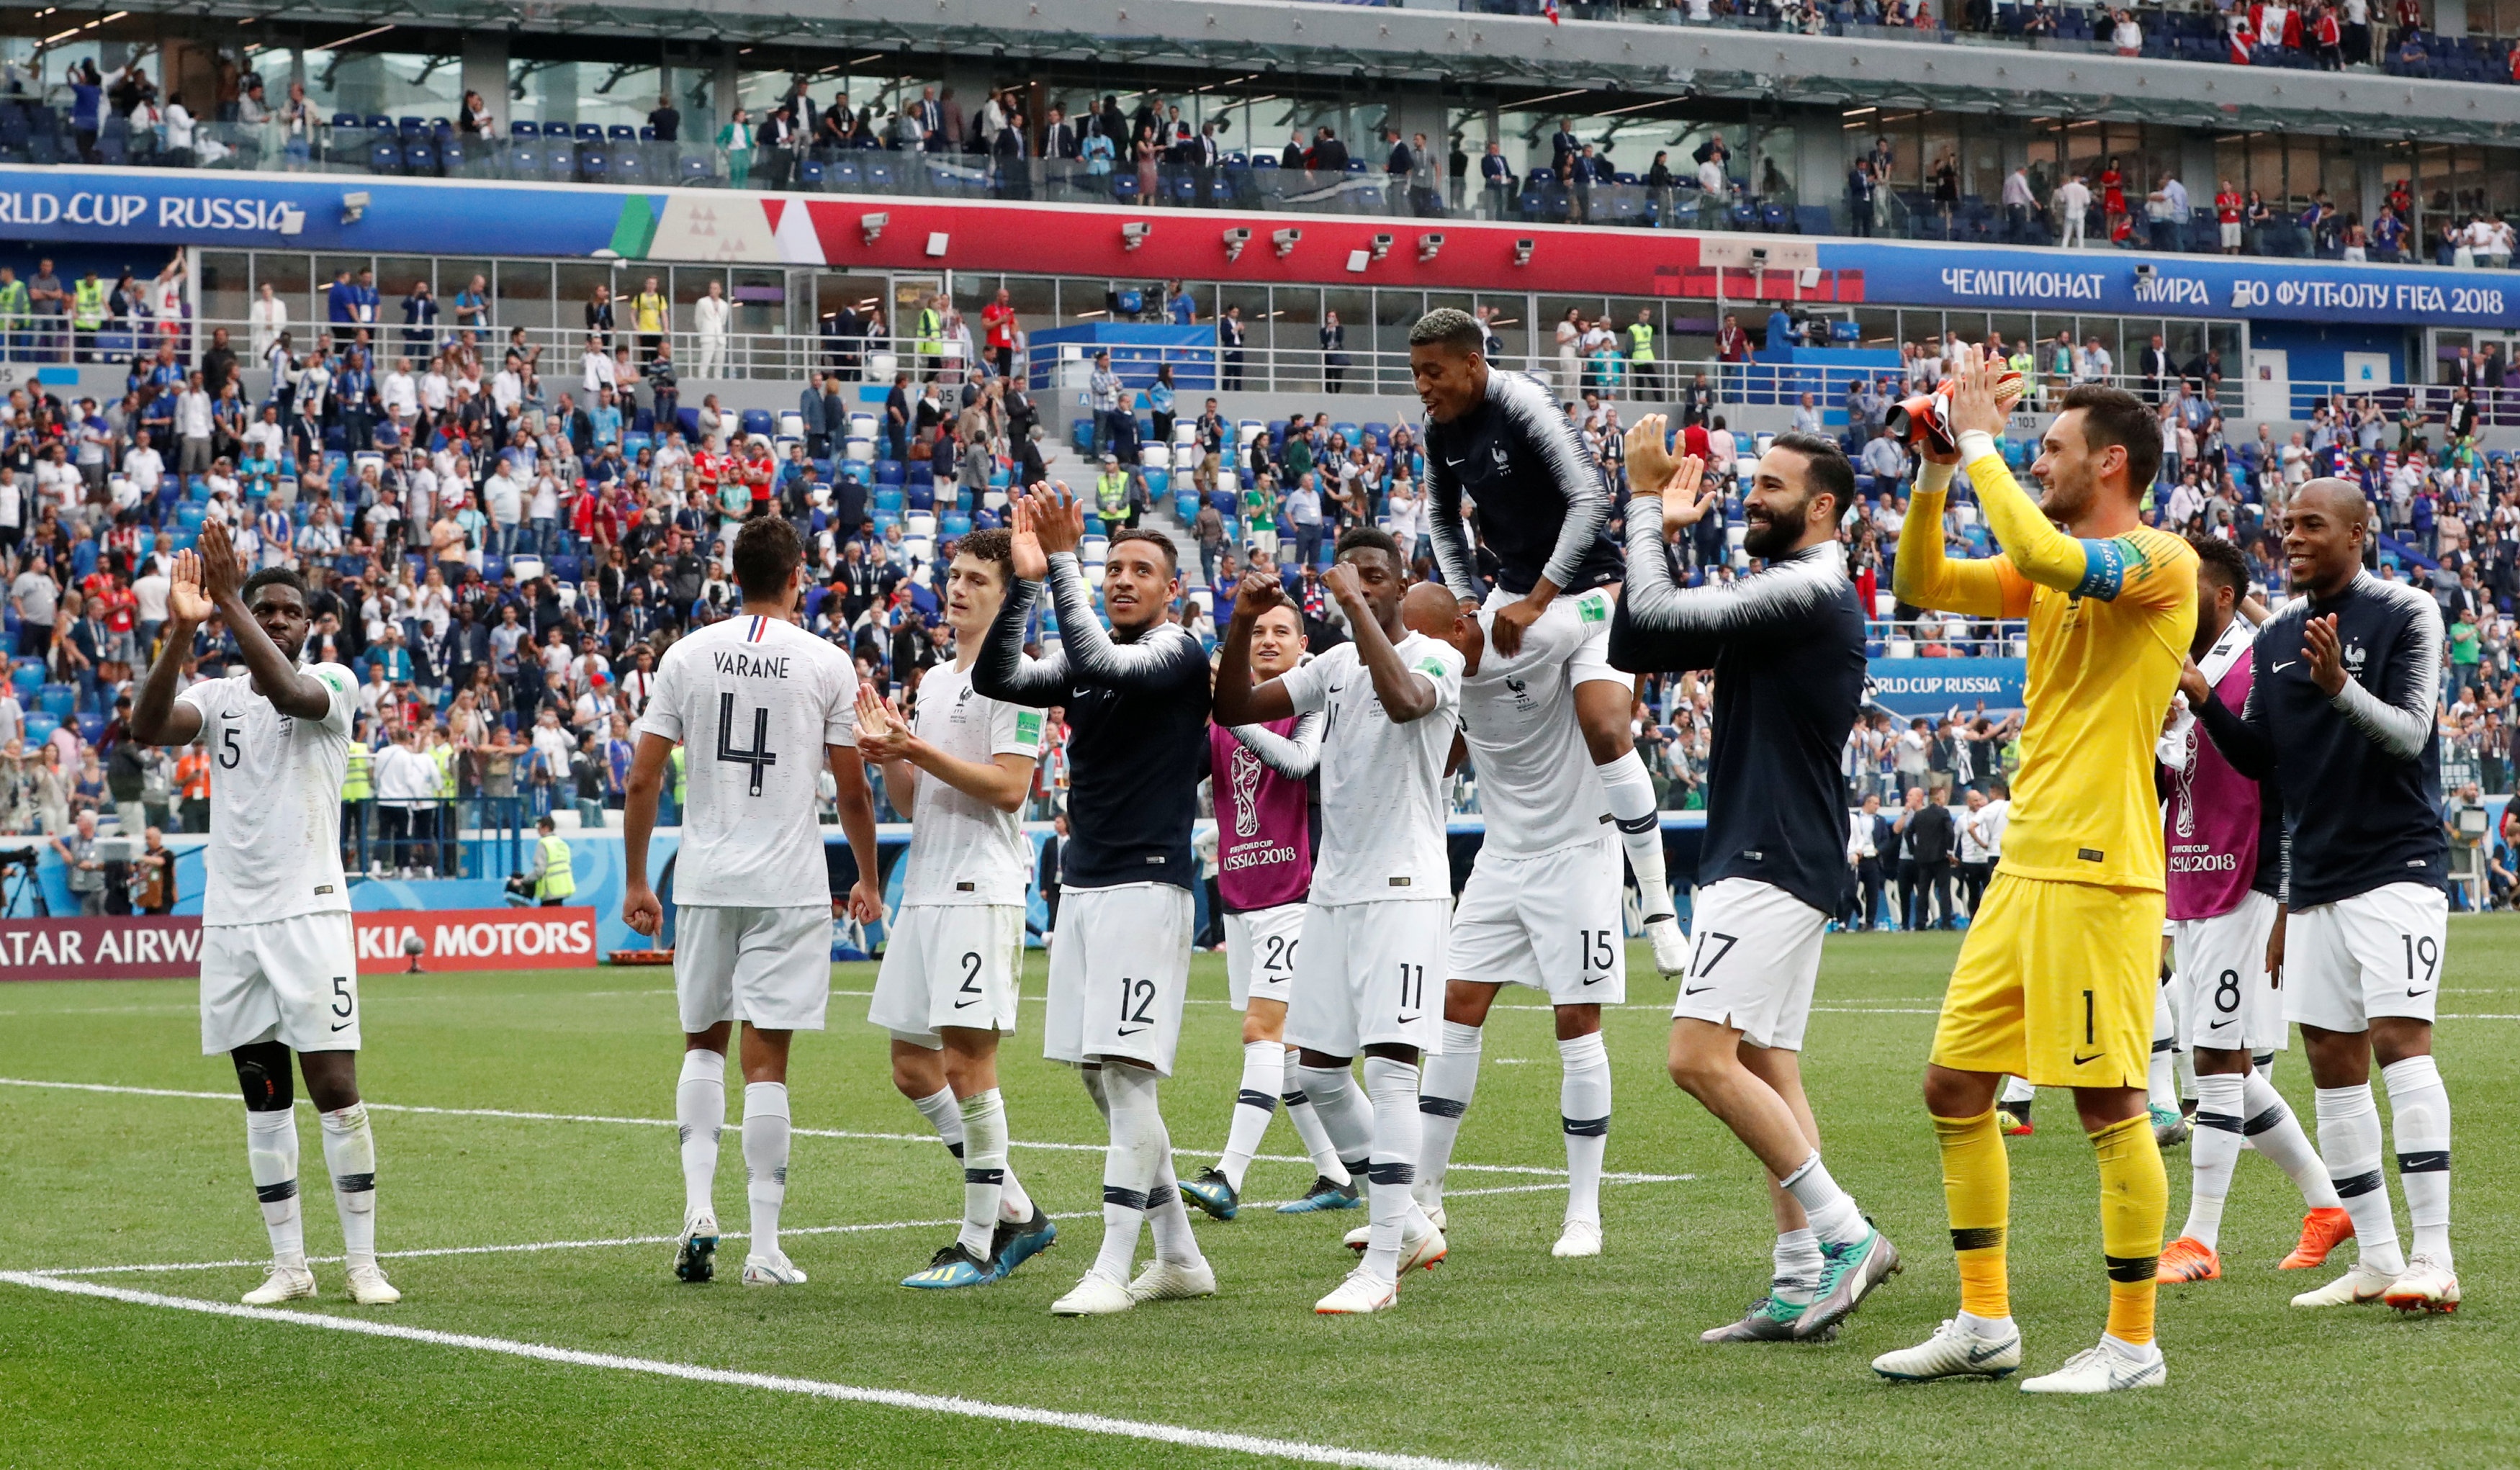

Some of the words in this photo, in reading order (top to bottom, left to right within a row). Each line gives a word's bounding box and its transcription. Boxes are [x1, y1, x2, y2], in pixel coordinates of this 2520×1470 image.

[68, 192, 147, 226] CUP
[158, 197, 289, 231] RUSSIA
[1941, 269, 2105, 299] ЧЕМПИОНАТ
[2276, 281, 2389, 310] ФУТБОЛУ
[2451, 288, 2504, 315] 2018
[939, 389, 954, 402] 05
[2018, 417, 2036, 428] 103
[714, 651, 791, 679] VARANE
[1910, 677, 1943, 693] CUP
[1945, 677, 2002, 693] RUSSIA
[219, 728, 240, 770] 5
[717, 692, 777, 798] 4
[1224, 852, 1259, 871] USSIA
[1259, 847, 1297, 865] 2018
[1259, 839, 1274, 848] CUP
[2191, 853, 2236, 872] 2018
[2192, 844, 2210, 853] CUP
[94, 929, 203, 964] AIRW
[358, 926, 423, 959] KIA
[433, 920, 593, 958] MOTORS
[1580, 929, 1614, 970] 15
[1689, 931, 1740, 978] 17
[2401, 934, 2438, 981] 19
[959, 951, 983, 994] 2
[1400, 962, 1423, 1009] 11
[2215, 968, 2241, 1014] 8
[331, 976, 353, 1018] 5
[1120, 977, 1156, 1025] 12
[2082, 990, 2094, 1045] 1
